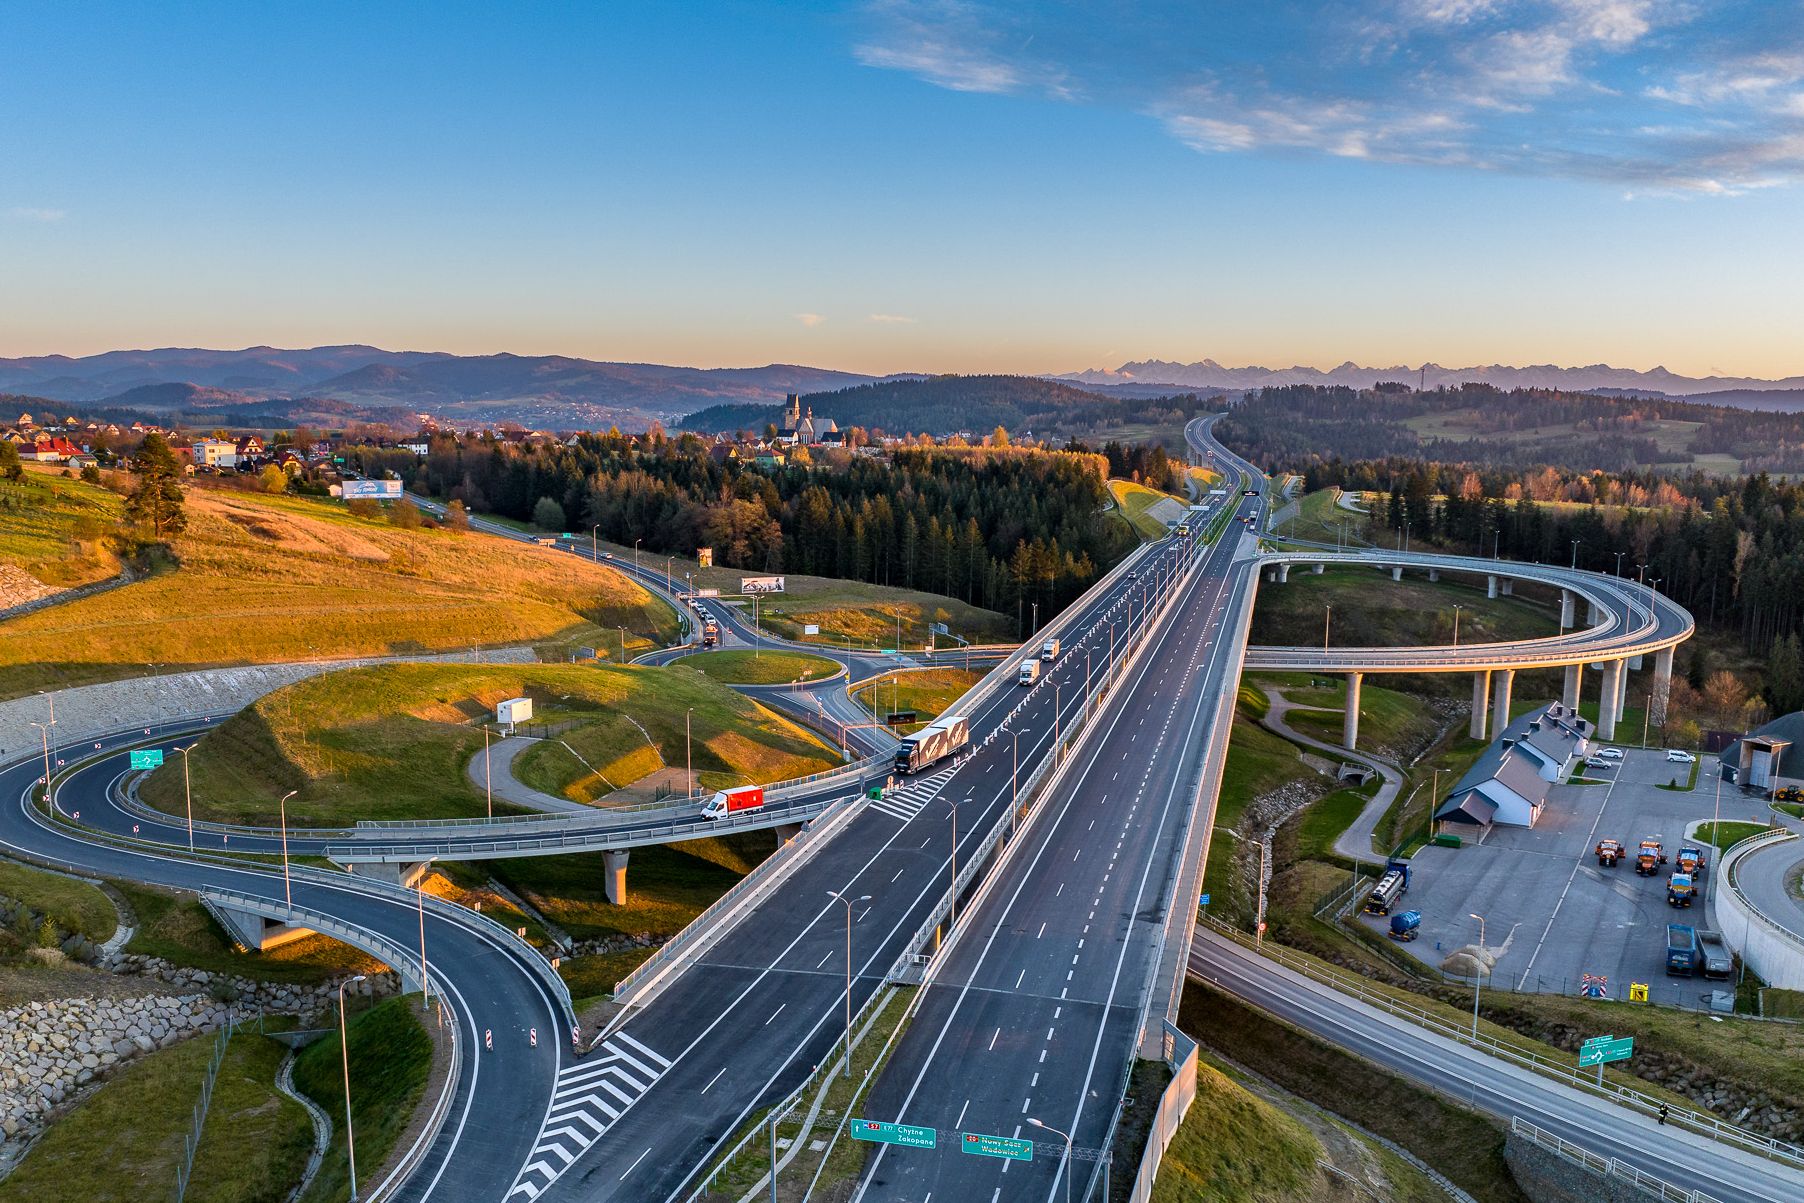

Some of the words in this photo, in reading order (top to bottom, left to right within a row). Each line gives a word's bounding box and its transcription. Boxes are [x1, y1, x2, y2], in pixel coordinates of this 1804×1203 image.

[897, 1135, 934, 1146] Zakopane
[981, 1137, 1001, 1147] Nowy
[981, 1145, 1019, 1156] Wadowice
